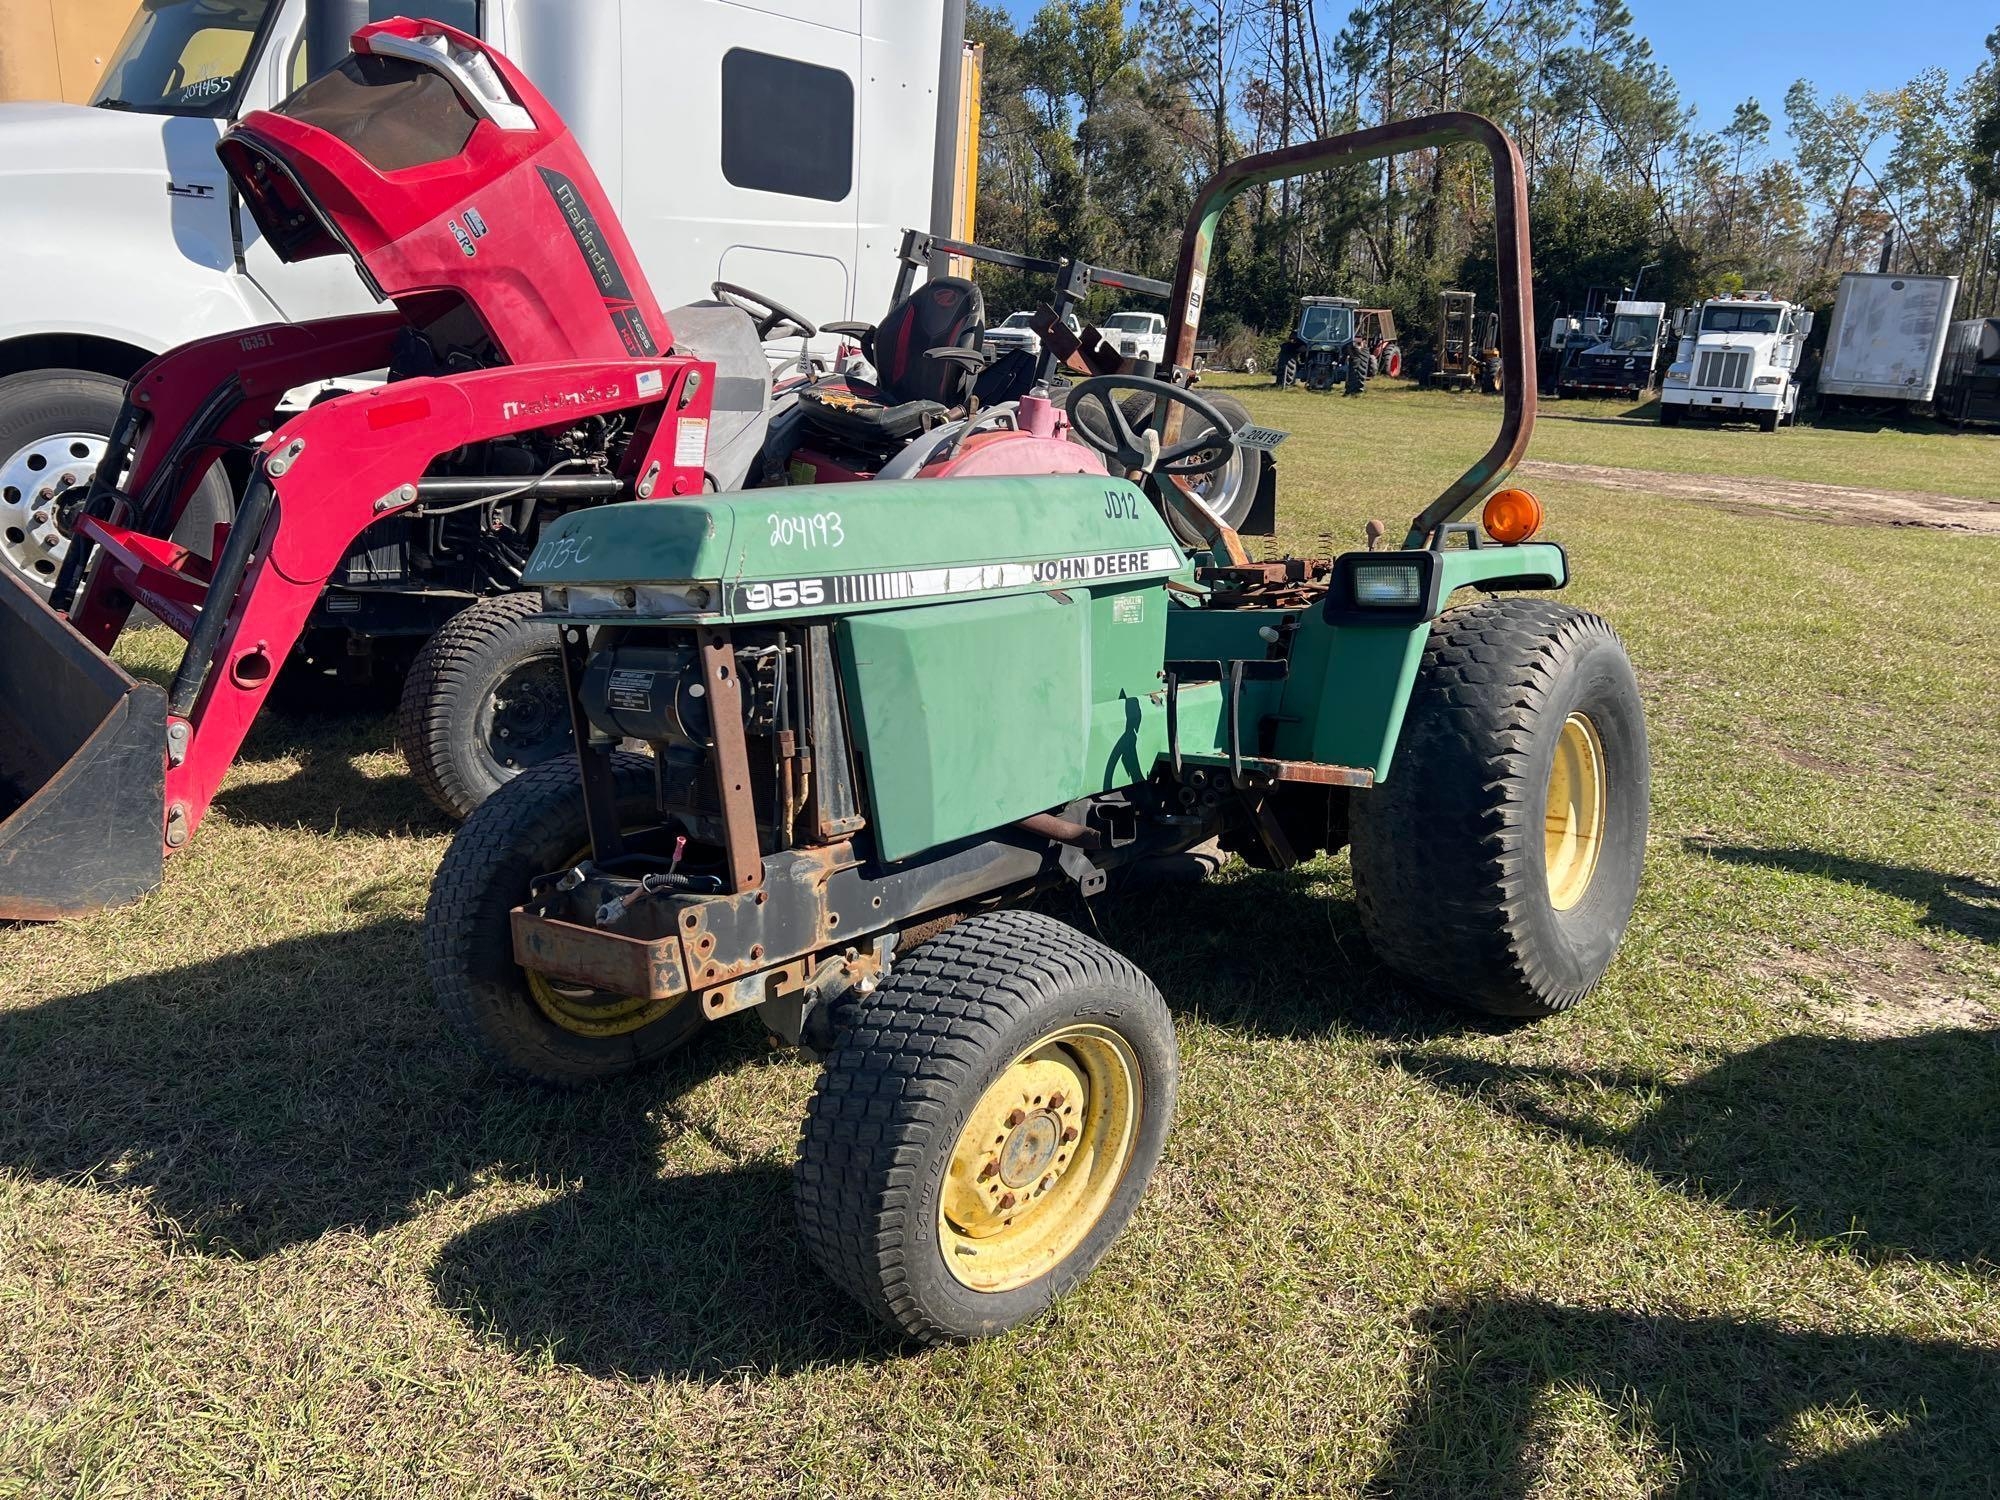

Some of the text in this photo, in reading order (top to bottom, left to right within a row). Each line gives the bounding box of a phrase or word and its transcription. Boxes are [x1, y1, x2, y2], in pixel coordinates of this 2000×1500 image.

[181, 77, 231, 103] 204455
[556, 183, 613, 289] Mahindra
[621, 328, 636, 352] HST
[631, 316, 651, 350] 1635
[1623, 357, 1636, 370] 2
[1247, 429, 1283, 445] 204193
[1104, 491, 1139, 520] JD12
[767, 511, 845, 551] 204193
[1033, 551, 1149, 582] JOHN DEERE
[745, 578, 825, 611] 955
